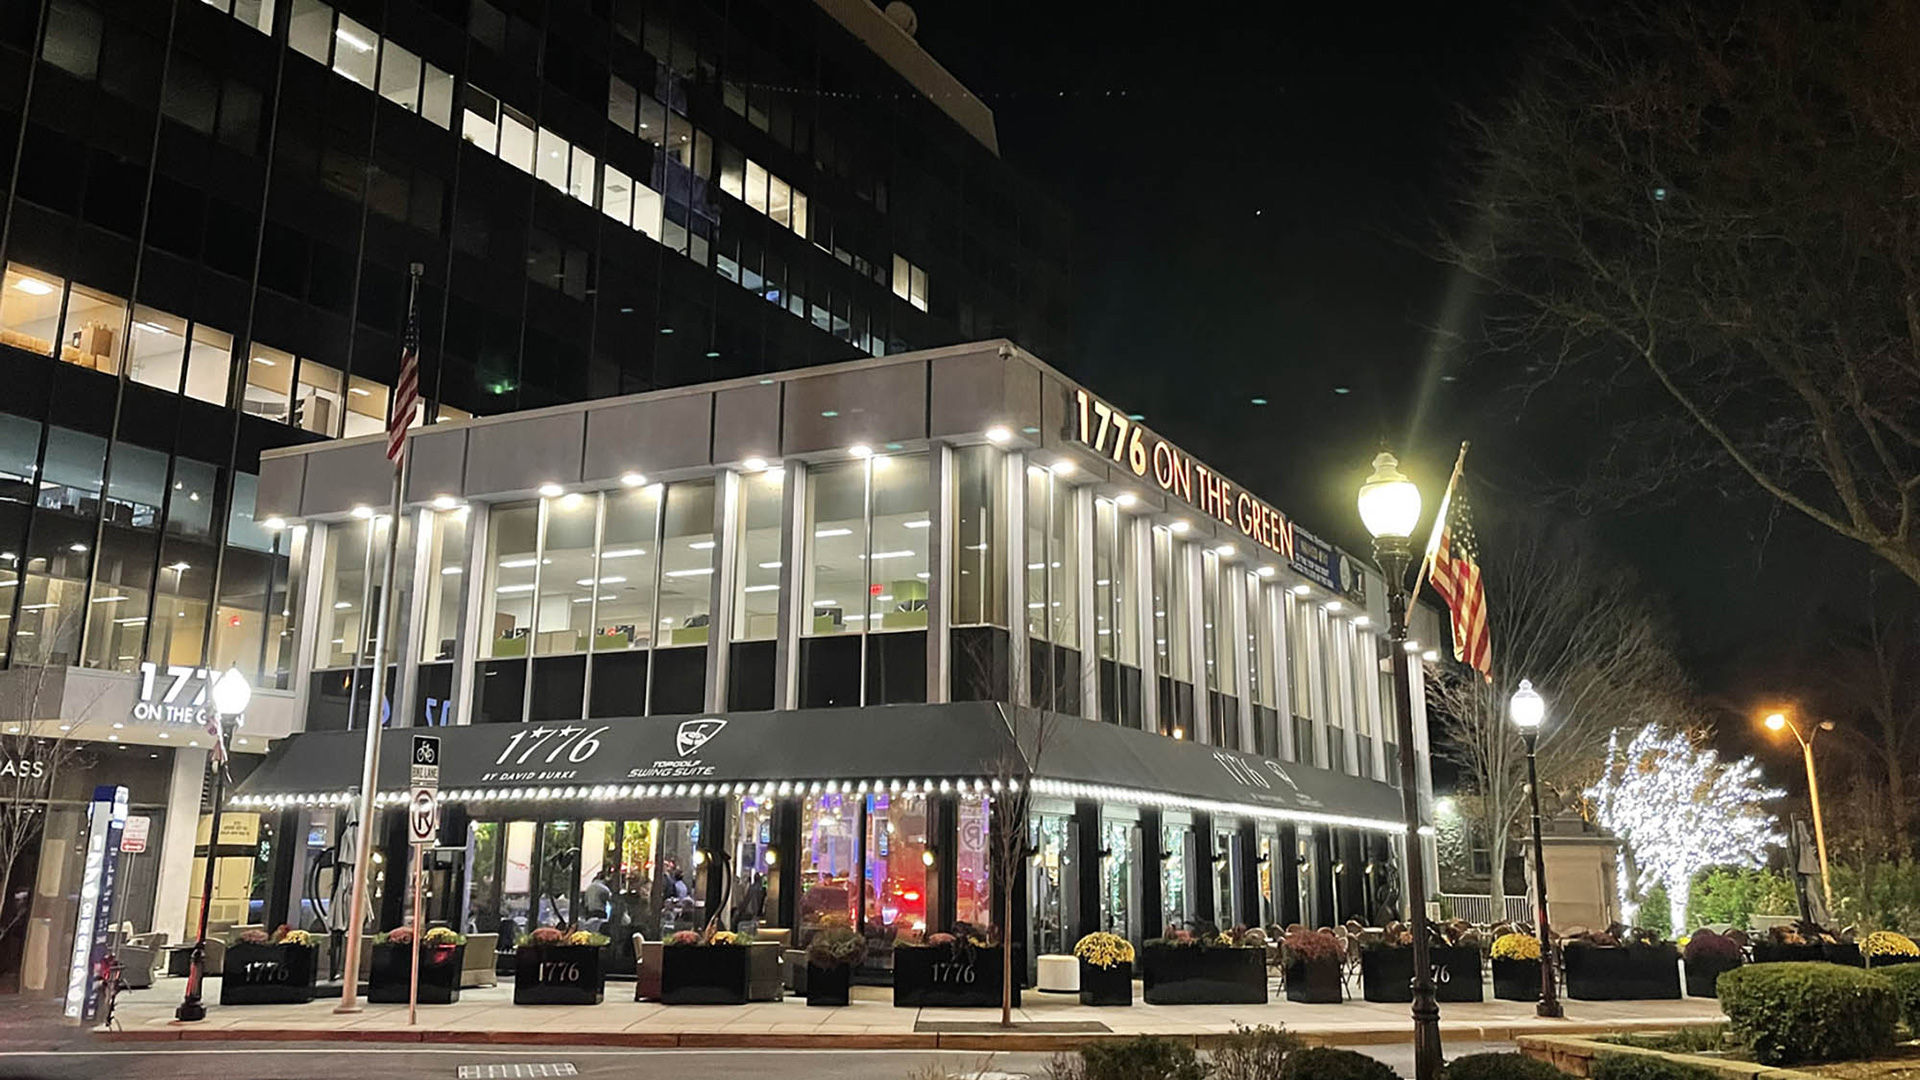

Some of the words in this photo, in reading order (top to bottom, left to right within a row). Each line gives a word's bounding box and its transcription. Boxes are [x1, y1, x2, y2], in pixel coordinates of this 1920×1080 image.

[1077, 389, 1147, 477] 1776
[1153, 440, 1191, 503] ON
[1196, 464, 1233, 526] THE
[1237, 492, 1294, 561] GREEN
[140, 662, 223, 706] 177
[133, 702, 162, 720] ON
[166, 705, 193, 723] THE
[496, 725, 610, 765] 1776
[0, 760, 44, 777] ASS
[627, 768, 673, 778] SWING
[672, 766, 715, 777] SUITE
[652, 760, 702, 768] TOPGOLF
[482, 773, 498, 781] BY
[499, 772, 536, 780] DAVID
[538, 770, 577, 780] BURKE
[244, 961, 289, 982] 1776
[539, 961, 580, 981] 1776
[931, 962, 975, 983] 1776
[1430, 963, 1451, 983] 76
